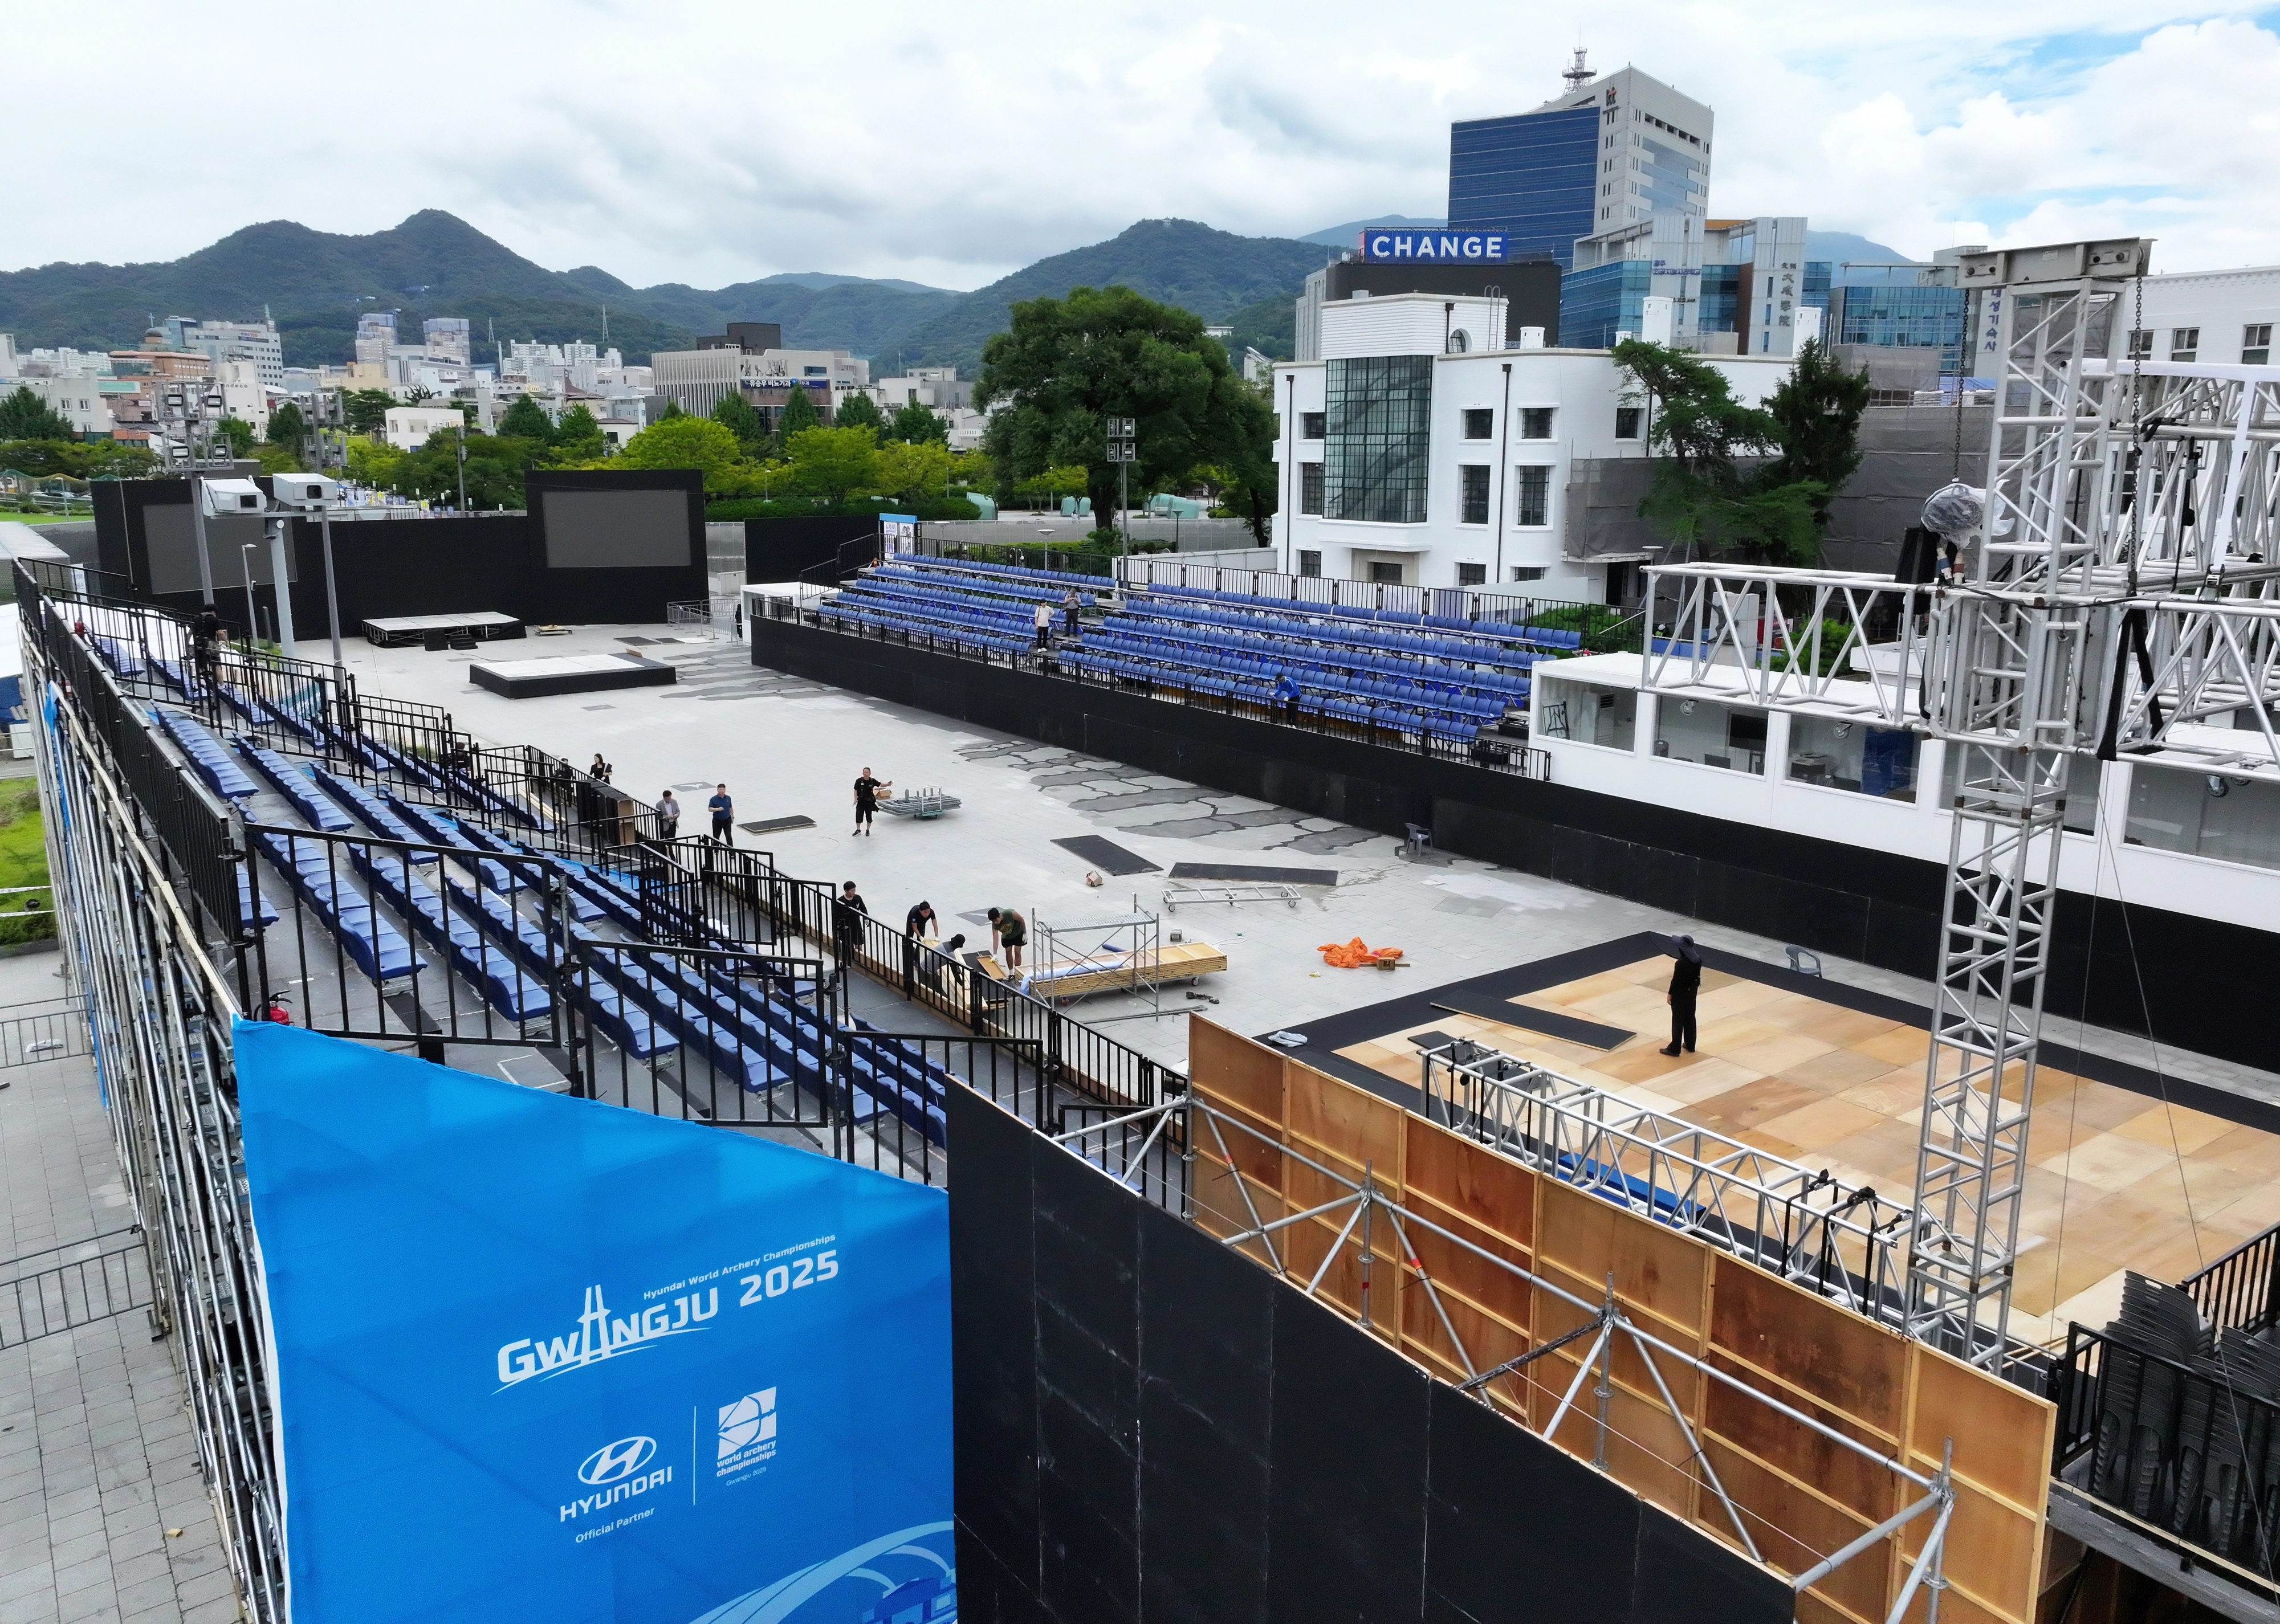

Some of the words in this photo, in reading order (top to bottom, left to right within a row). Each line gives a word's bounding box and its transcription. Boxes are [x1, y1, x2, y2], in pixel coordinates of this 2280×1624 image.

[1372, 236, 1502, 258] CHANGE
[644, 1279, 685, 1300] Hyundai
[689, 1270, 719, 1286] World
[722, 1258, 761, 1275] Archery
[763, 1234, 836, 1262] Championships
[498, 1284, 718, 1383] GWANGJU
[740, 1250, 838, 1307] 2025
[716, 1451, 742, 1468] world
[743, 1439, 776, 1458] archery
[716, 1449, 776, 1477] championships
[726, 1473, 752, 1486] Gwangju
[752, 1466, 767, 1476] 2025
[560, 1466, 672, 1523] HYUNDAI
[575, 1521, 614, 1543] Official
[616, 1507, 655, 1529] Partner
